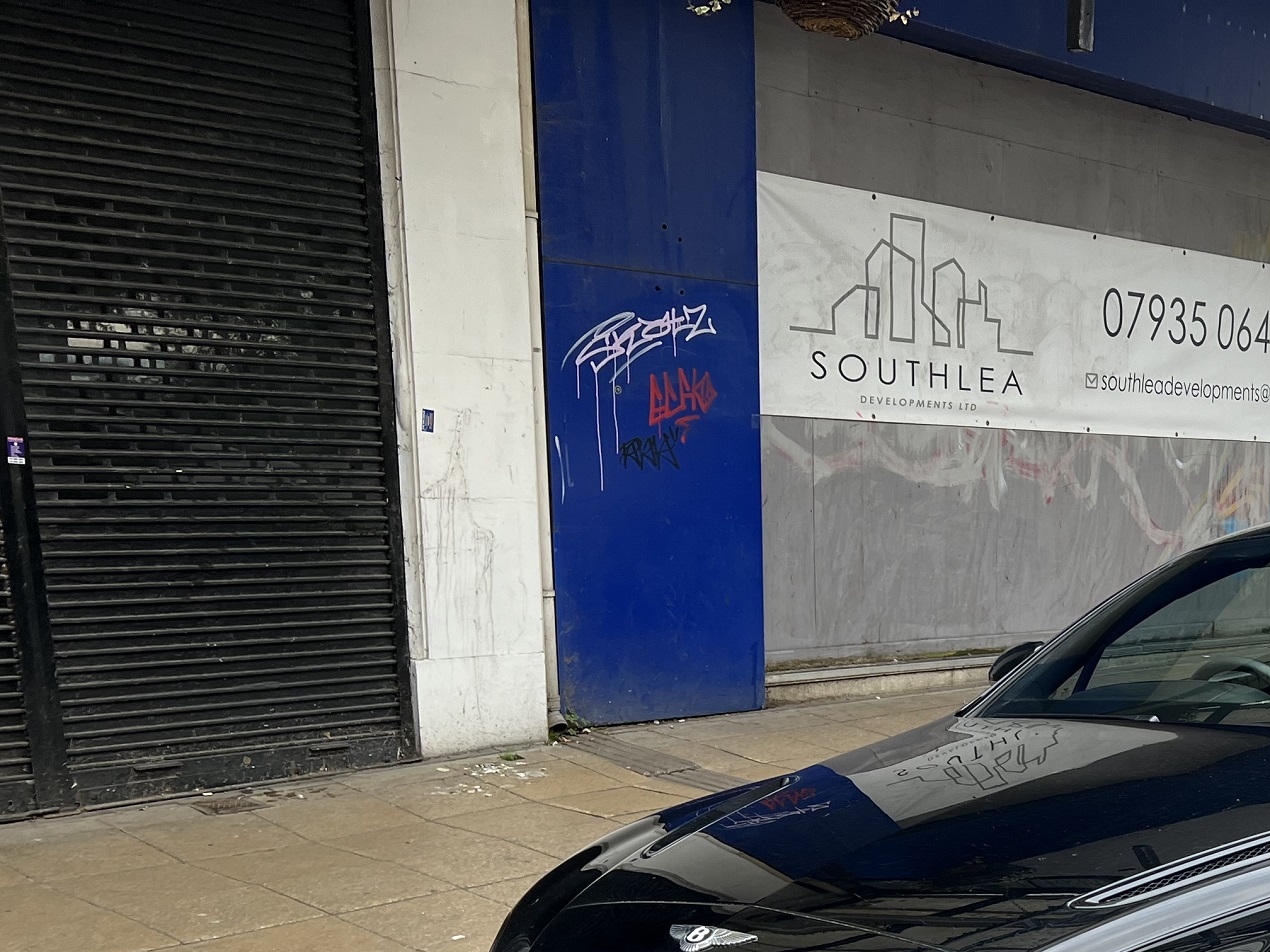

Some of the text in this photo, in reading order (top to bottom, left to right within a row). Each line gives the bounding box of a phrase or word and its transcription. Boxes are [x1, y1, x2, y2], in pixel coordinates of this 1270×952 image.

[1103, 288, 1207, 347] 07935
[1217, 304, 1270, 353] 064
[810, 350, 1023, 396] SOUTHLEA
[860, 395, 977, 412] DEVELOPMENTS LTD
